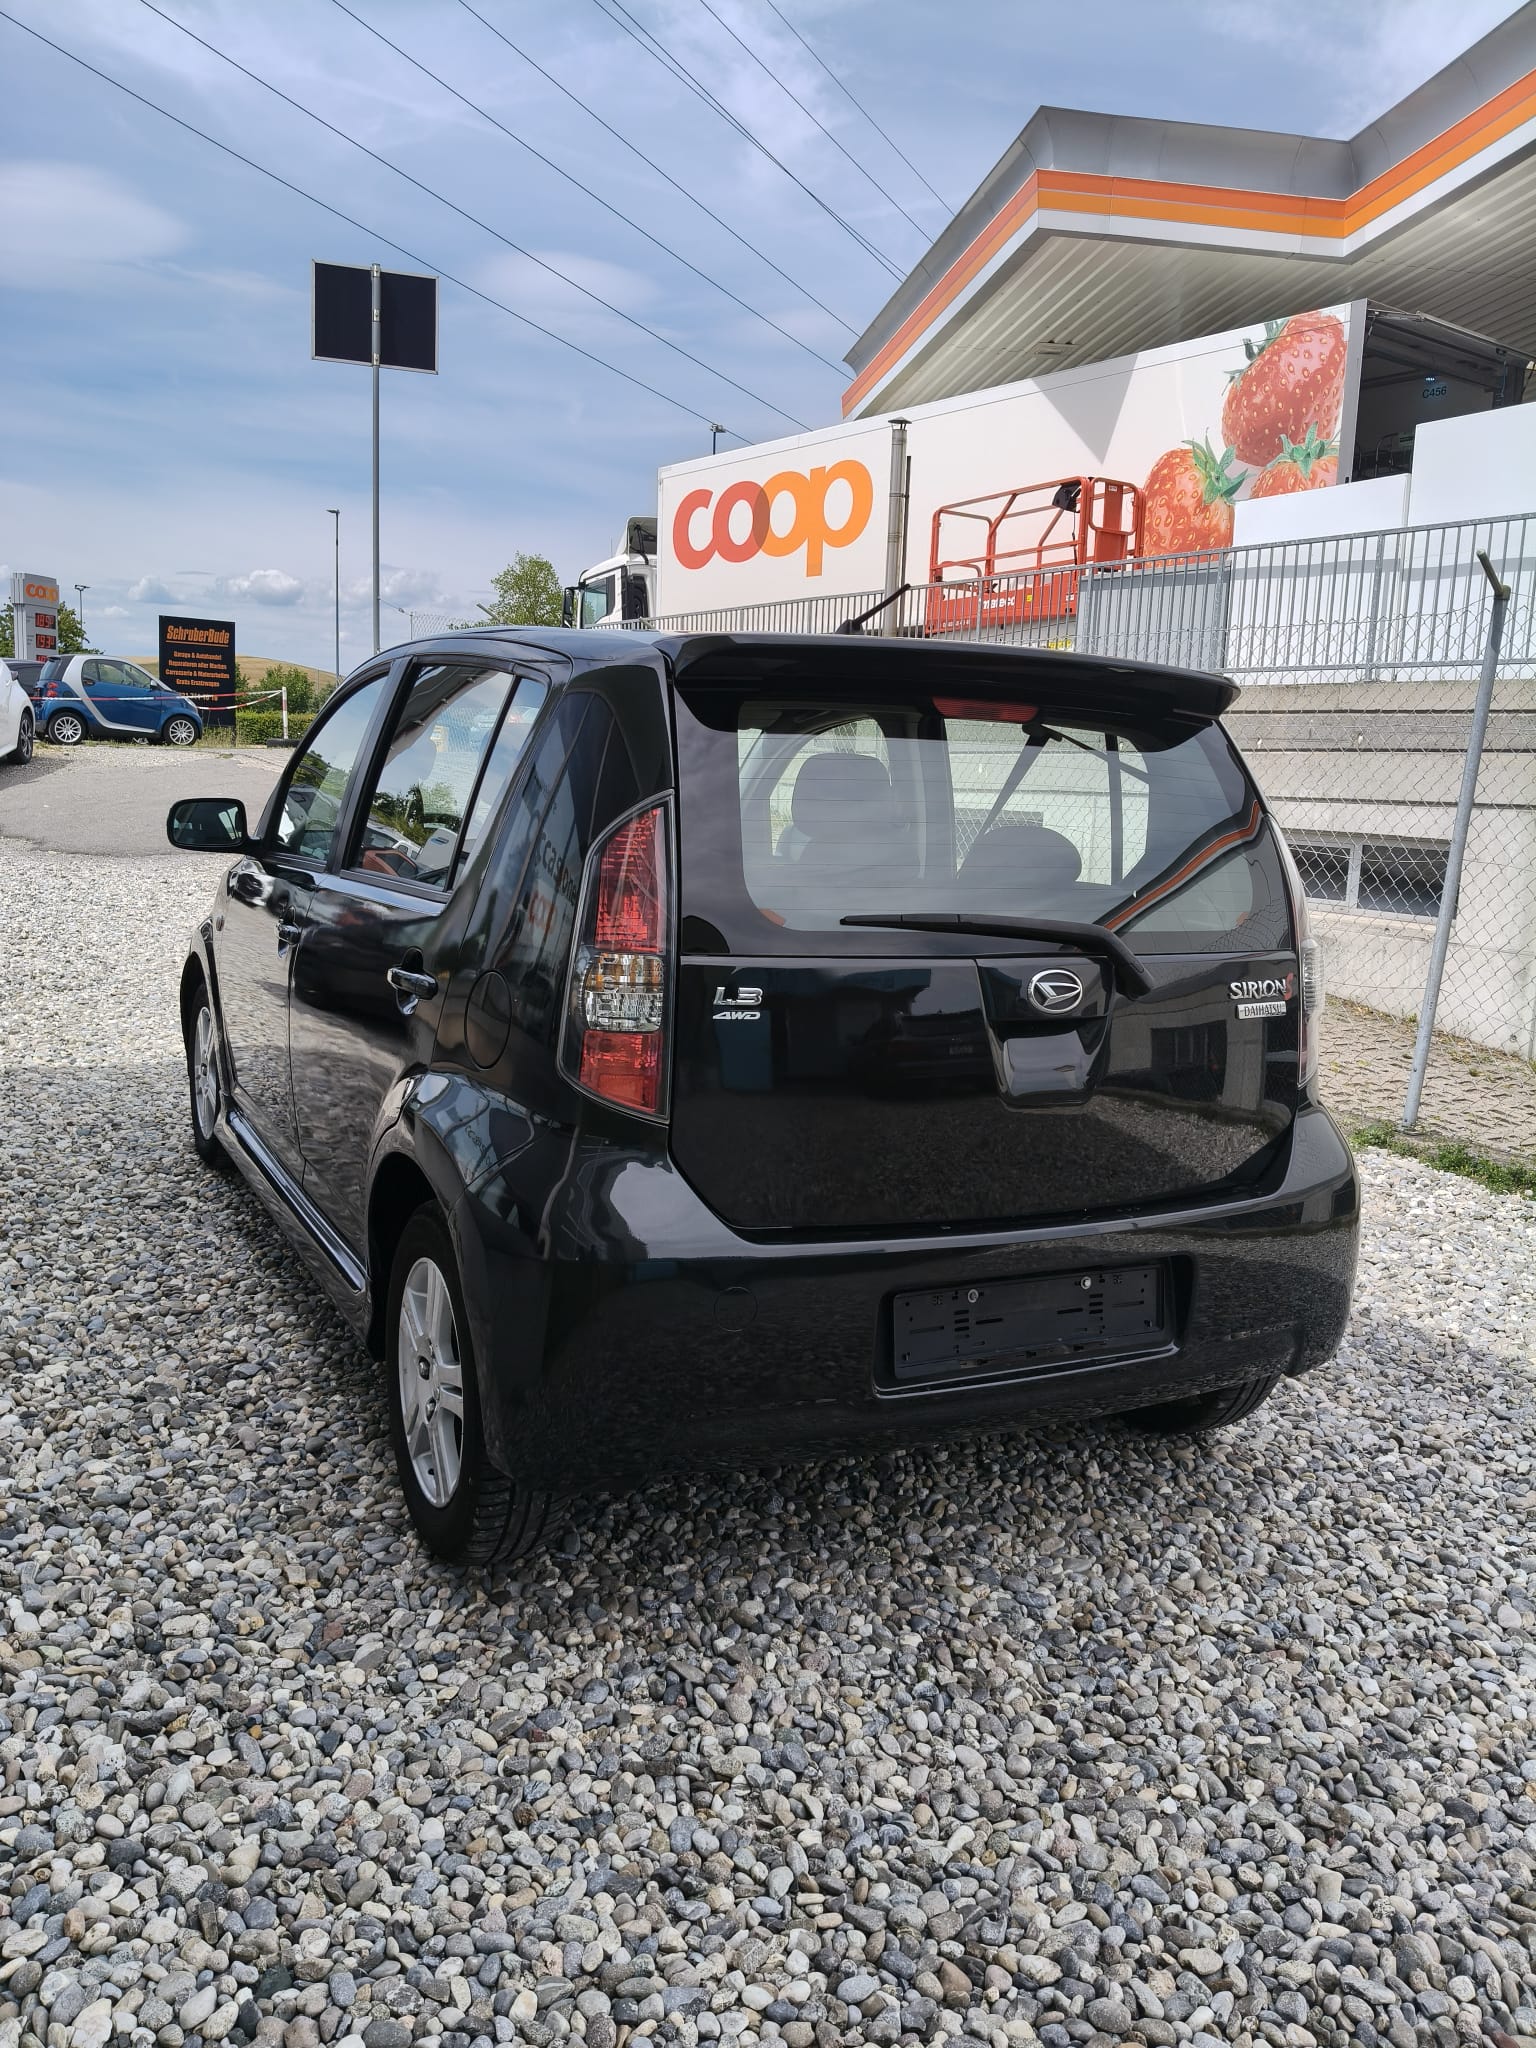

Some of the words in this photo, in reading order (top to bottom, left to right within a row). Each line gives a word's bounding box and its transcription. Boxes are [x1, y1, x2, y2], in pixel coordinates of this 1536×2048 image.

[1422, 386, 1447, 399] C456
[673, 459, 873, 577] coop
[25, 583, 58, 603] coop
[1230, 979, 1287, 1000] SIRION
[712, 1011, 761, 1020] 4WD
[1243, 1003, 1283, 1018] DAIHATSU
